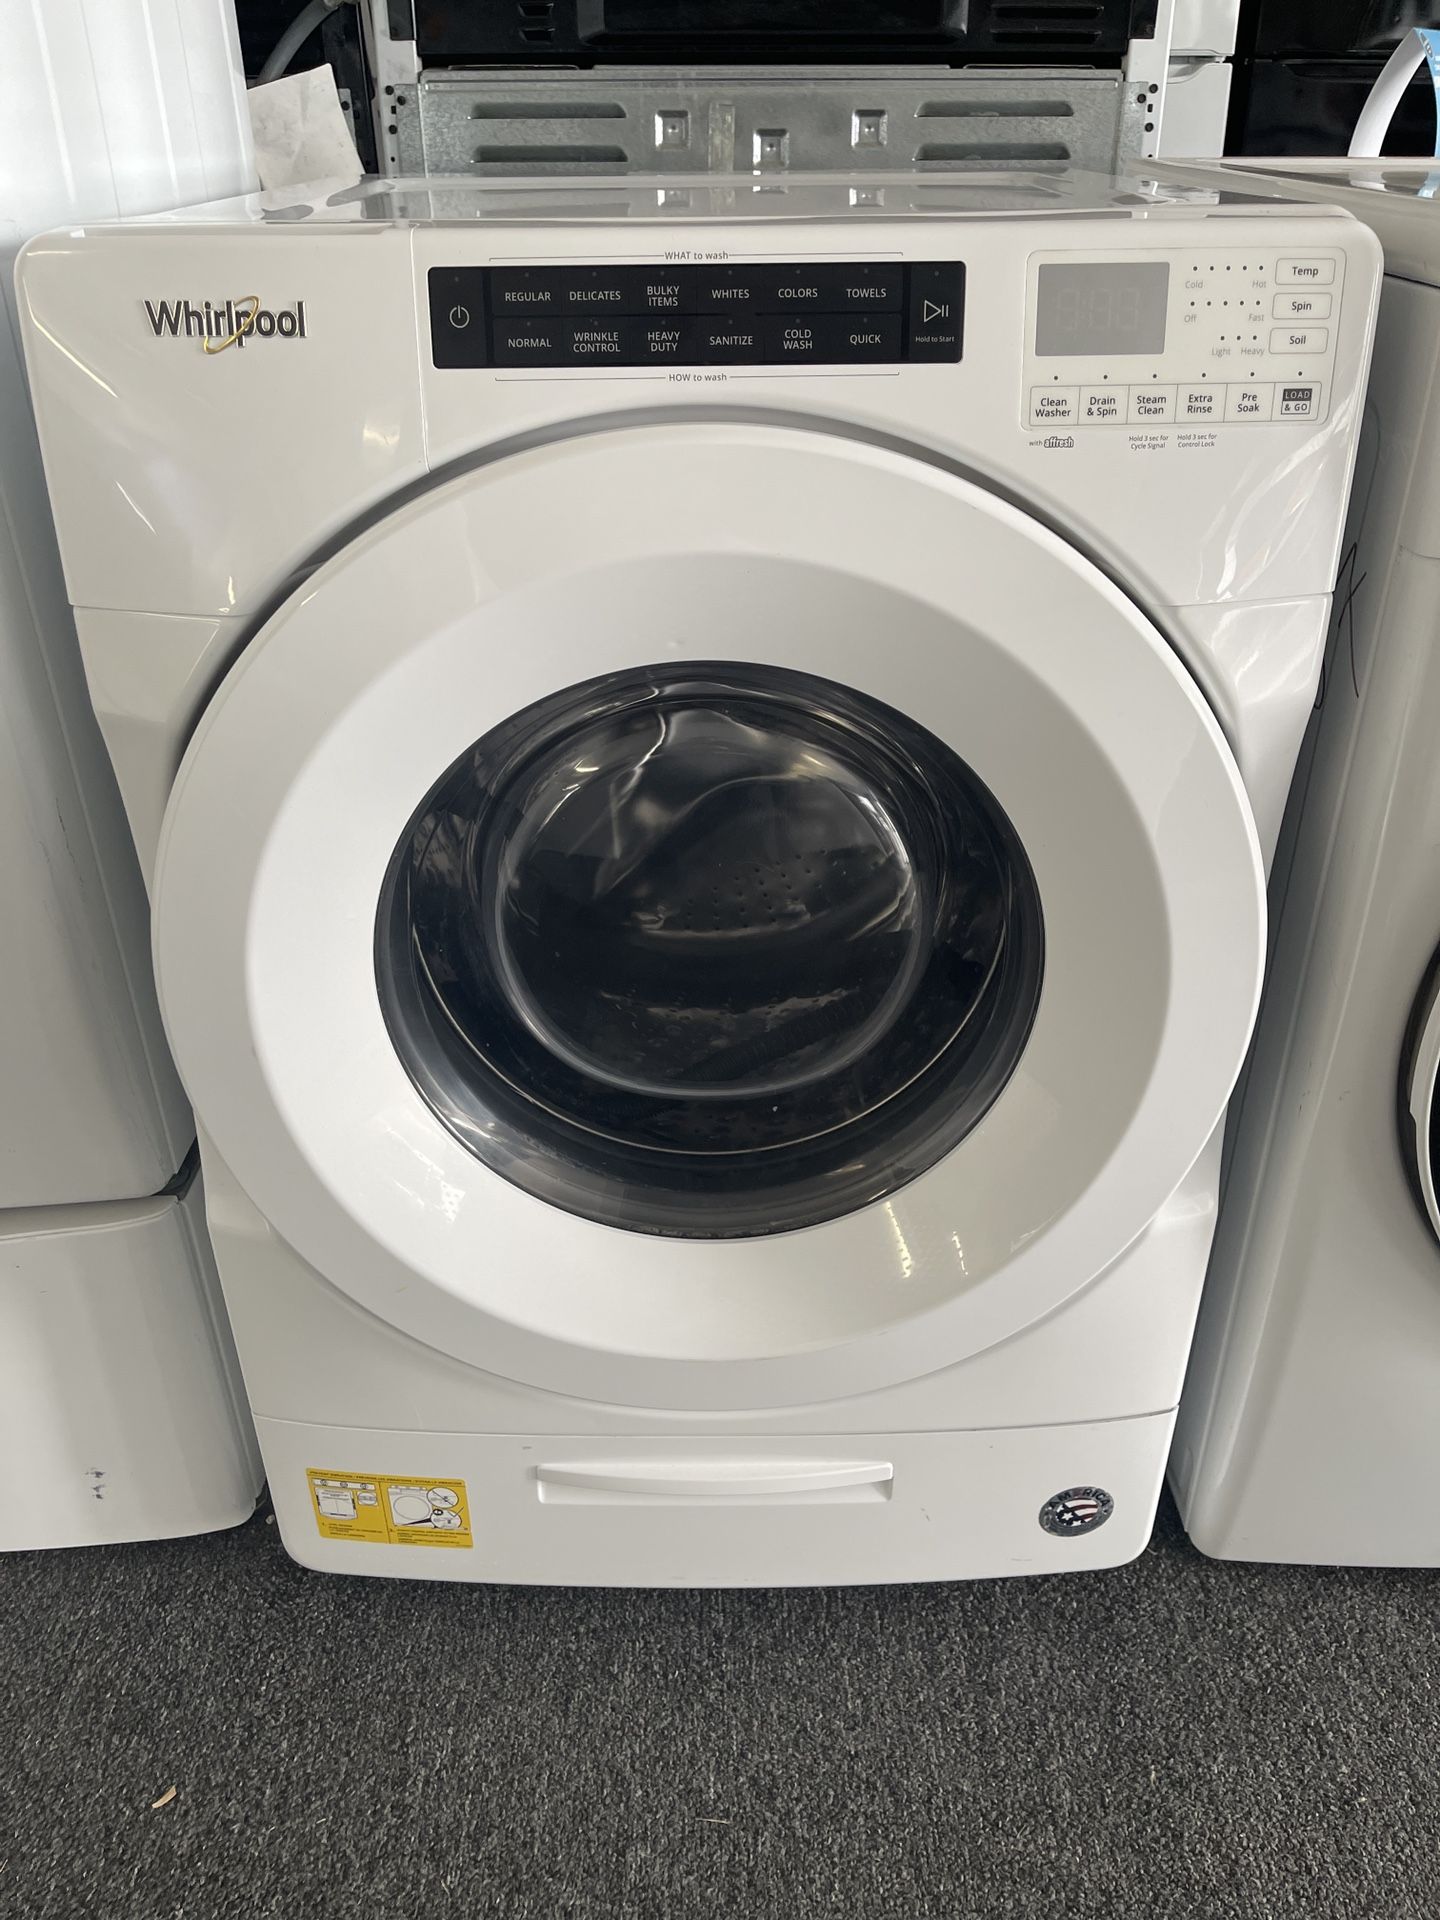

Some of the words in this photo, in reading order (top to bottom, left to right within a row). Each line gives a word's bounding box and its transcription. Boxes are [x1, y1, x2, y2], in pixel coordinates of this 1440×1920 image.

[664, 251, 691, 260] WHAT
[693, 252, 703, 260] to
[705, 250, 729, 260] wash
[1292, 266, 1319, 278] Temp
[1185, 280, 1204, 289] Cold
[1252, 280, 1267, 288] Hot
[569, 290, 621, 301] DELICATES
[647, 285, 680, 296] BULKY
[711, 288, 750, 299] WHITES
[777, 288, 818, 298] COLORS
[846, 288, 887, 298] TOWELS
[504, 291, 551, 302] REGULAR
[648, 296, 679, 307] ITEMS
[1291, 301, 1312, 312] Spin
[1184, 314, 1197, 323] Off
[1248, 313, 1265, 322] Fast
[143, 299, 308, 348] Whirlpool
[573, 331, 619, 342] WRINKLE
[647, 331, 680, 341] HEAVY
[784, 329, 812, 339] COLD
[507, 338, 552, 348] NORMAL
[709, 335, 753, 346] SANITIZE
[849, 334, 882, 345] QUICK
[1289, 335, 1307, 345] Soil
[573, 342, 621, 353] CONTROL
[650, 342, 678, 352] DUTY
[783, 340, 813, 350] WASH
[1211, 347, 1231, 358] Light
[1240, 347, 1265, 357] Heavy
[668, 373, 691, 382] HOW
[693, 374, 702, 382] to
[704, 373, 727, 382] wash
[1136, 395, 1167, 404] Steam
[1188, 394, 1213, 403] Extra
[1242, 393, 1258, 402] Pre
[1285, 390, 1311, 399] LOAD
[1040, 397, 1067, 407] Clean
[1089, 396, 1116, 405] Drain
[1086, 407, 1094, 416] &
[1096, 406, 1117, 418] Spin
[1137, 405, 1164, 415] Clean
[1187, 403, 1212, 413] Rinse
[1237, 403, 1260, 413] Soak
[1294, 403, 1308, 411] GO
[1035, 407, 1072, 418] Washer
[1043, 436, 1074, 448] affresh
[1147, 442, 1166, 450] Signal
[1049, 1487, 1112, 1509] AMRICA
